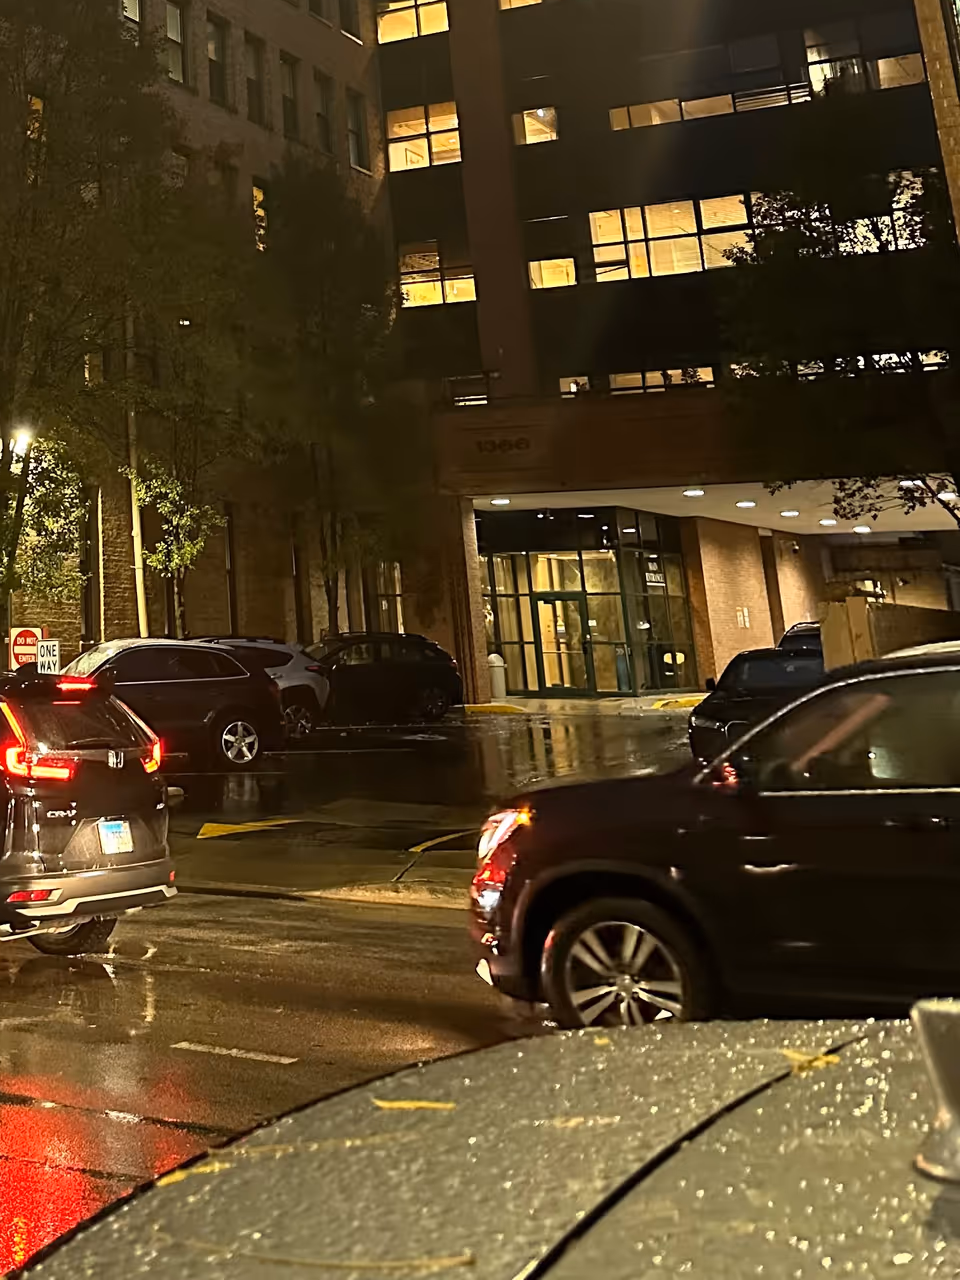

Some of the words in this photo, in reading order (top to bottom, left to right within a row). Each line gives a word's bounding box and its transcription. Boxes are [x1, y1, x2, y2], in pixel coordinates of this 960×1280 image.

[16, 637, 25, 645] DO
[26, 637, 37, 645] NOT
[40, 644, 57, 658] ONE
[18, 654, 36, 663] ENTER
[40, 660, 57, 673] WAY
